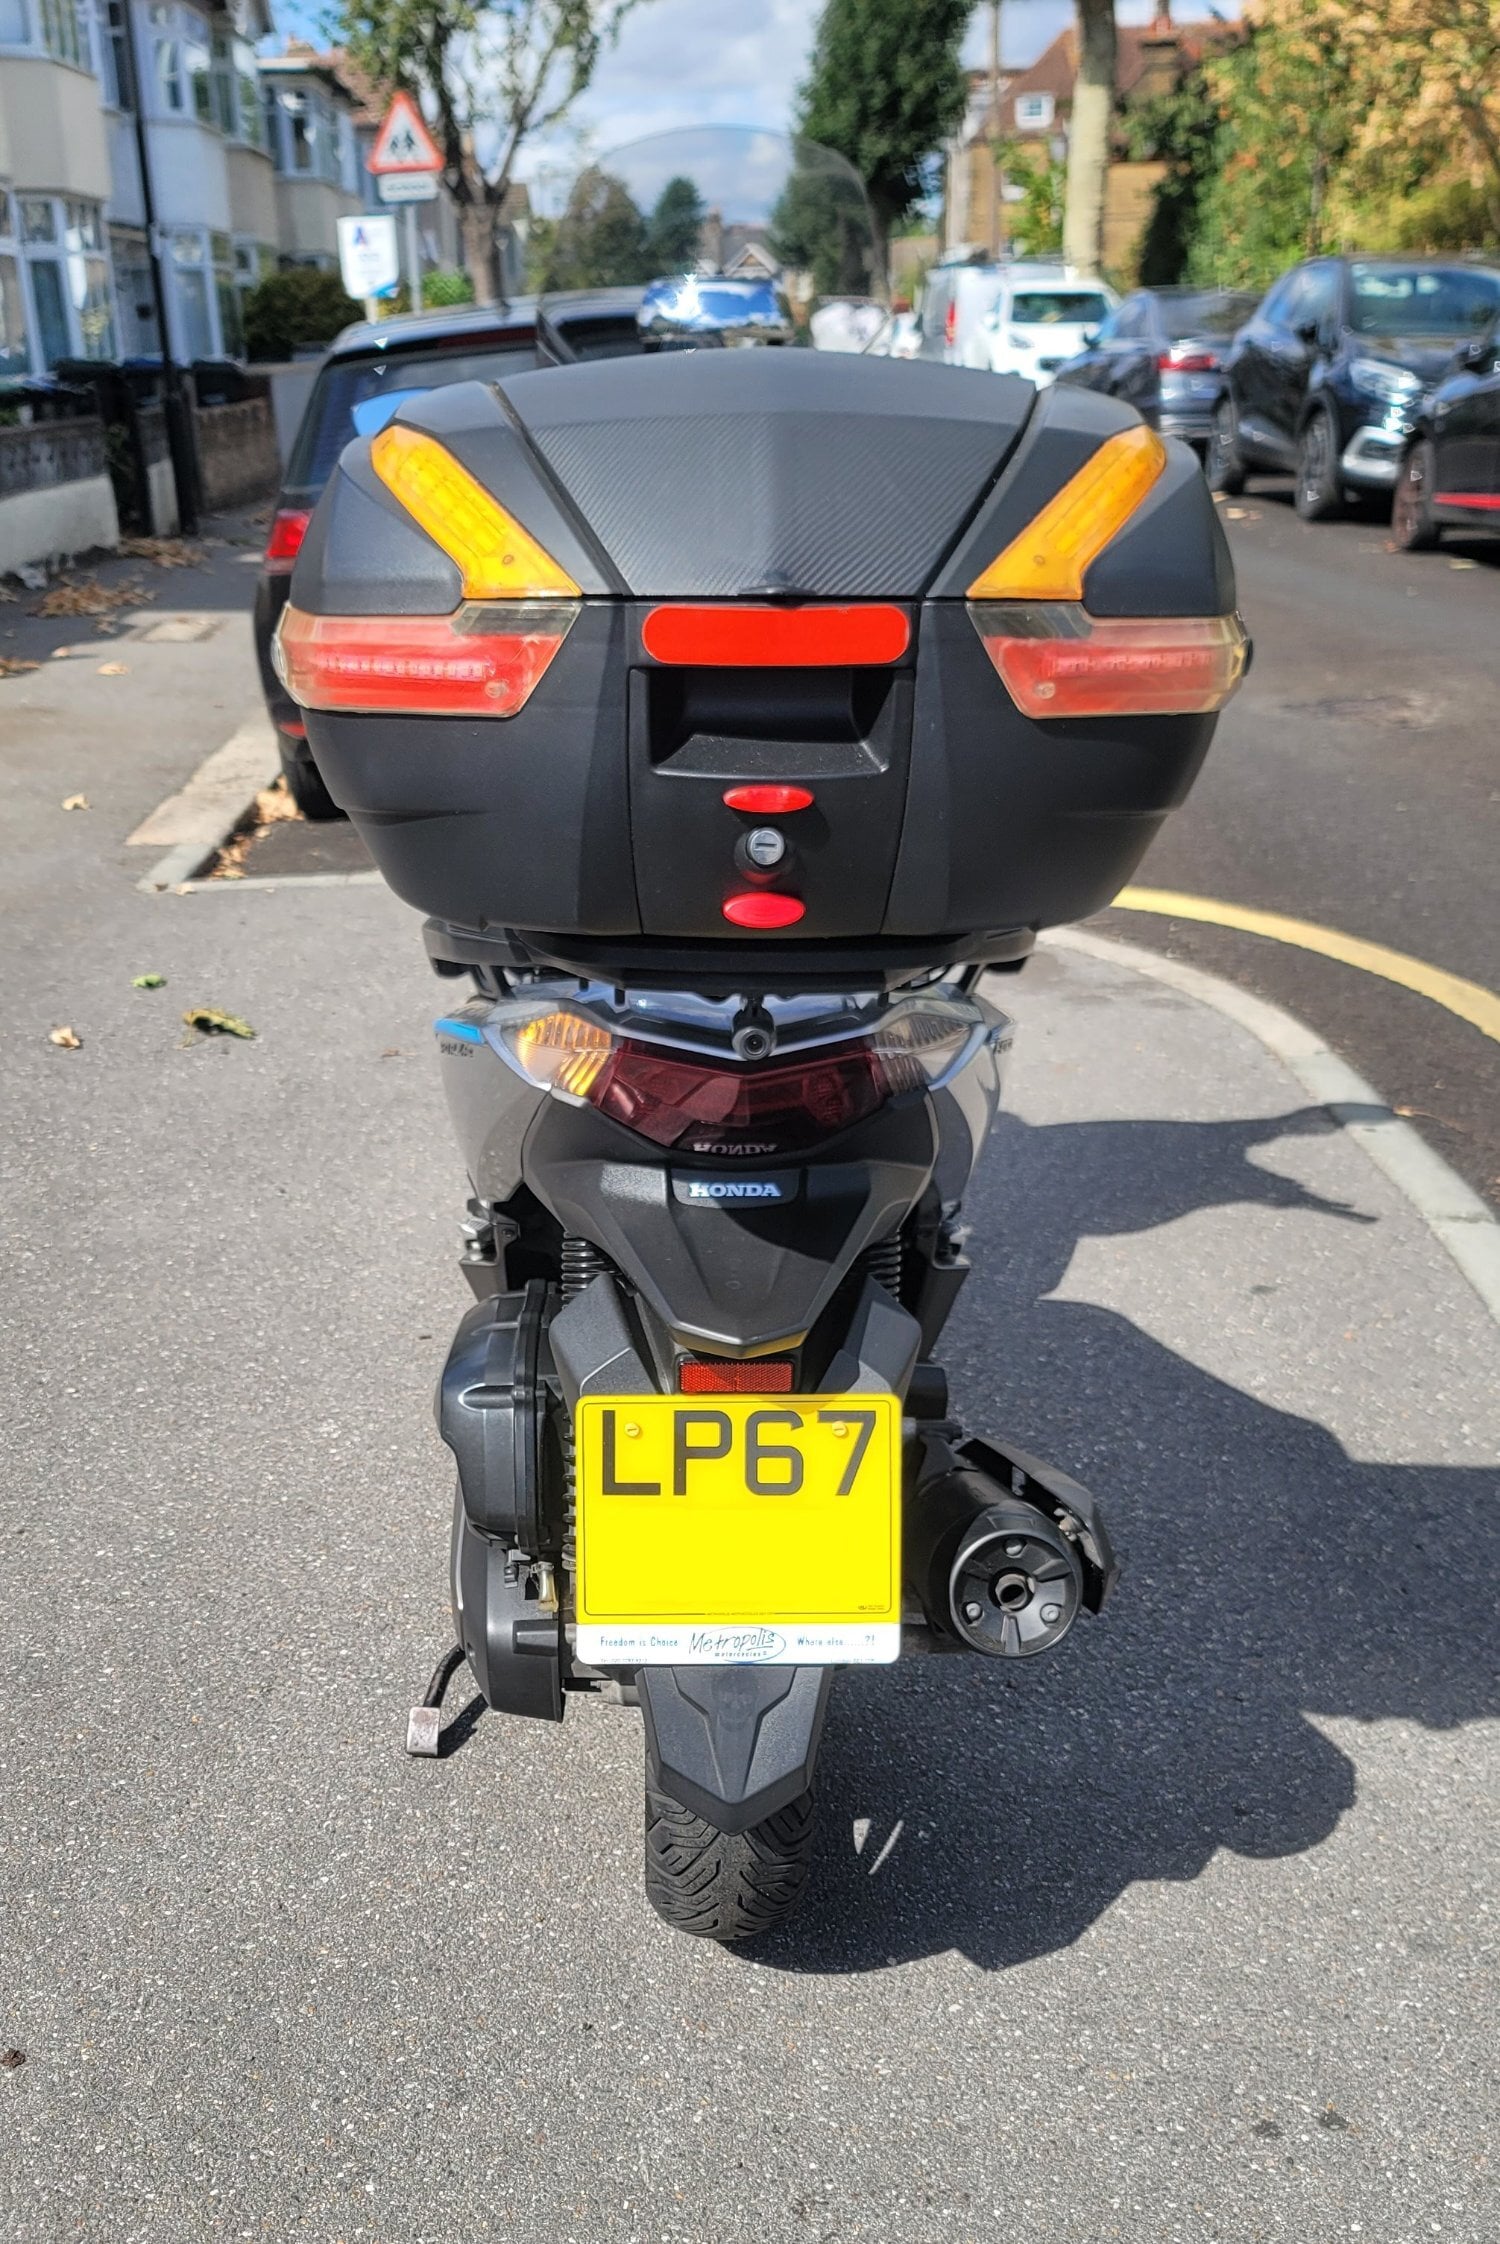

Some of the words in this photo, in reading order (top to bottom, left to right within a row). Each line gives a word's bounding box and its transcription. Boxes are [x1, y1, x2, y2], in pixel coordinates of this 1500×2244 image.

[689, 1182, 782, 1197] HONDA
[602, 1409, 877, 1496] LP67
[600, 1636, 635, 1646] Freedom
[639, 1639, 647, 1647] is
[650, 1636, 679, 1647] Choice
[689, 1627, 775, 1654] Metropolis
